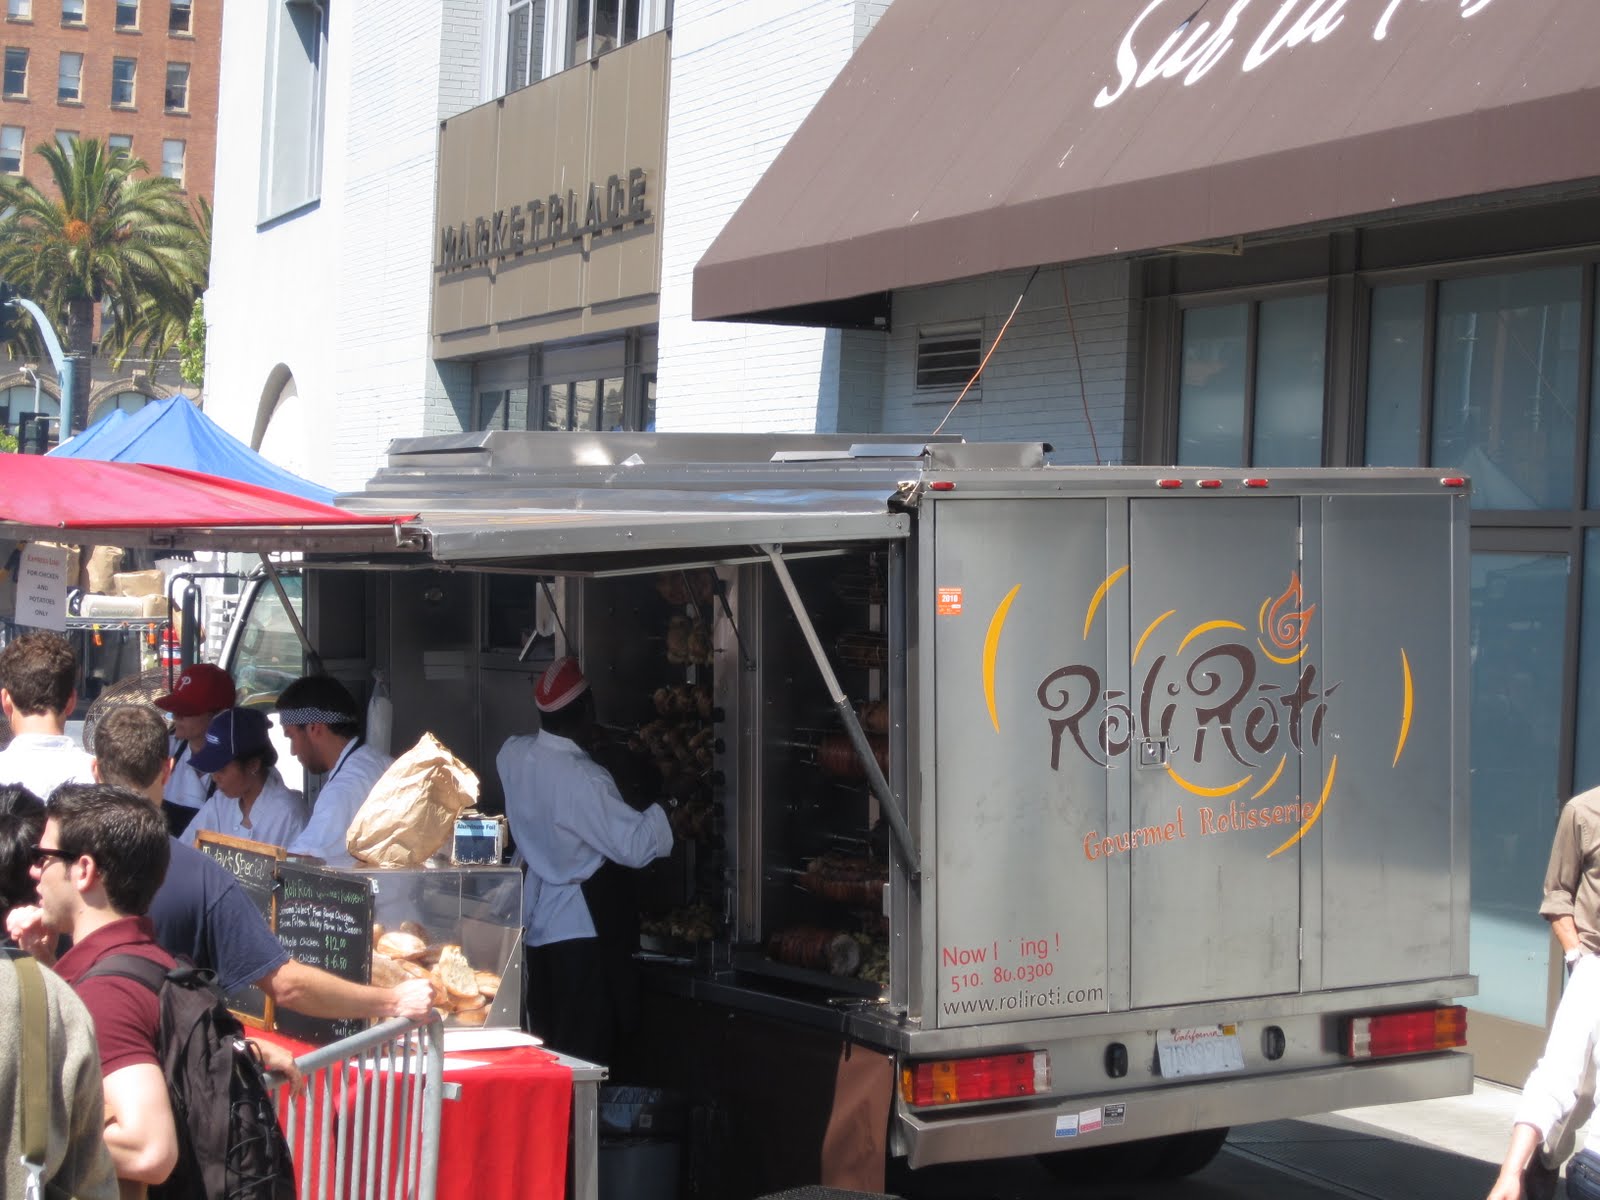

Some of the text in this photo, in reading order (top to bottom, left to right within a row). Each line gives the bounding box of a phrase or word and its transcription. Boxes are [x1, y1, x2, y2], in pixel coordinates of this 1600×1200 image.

[440, 167, 650, 268] MARKETPLACE
[27, 569, 59, 580] FOR CHICKEN
[29, 595, 56, 606] POTATOES
[941, 594, 959, 603] 2010
[34, 608, 48, 617] ONLY
[178, 676, 191, 691] P
[1082, 795, 1316, 861] Gourmet Rotisserie
[943, 946, 987, 967] Now
[943, 986, 1104, 1015] www.roliroti.com
[1173, 1028, 1219, 1044] California
